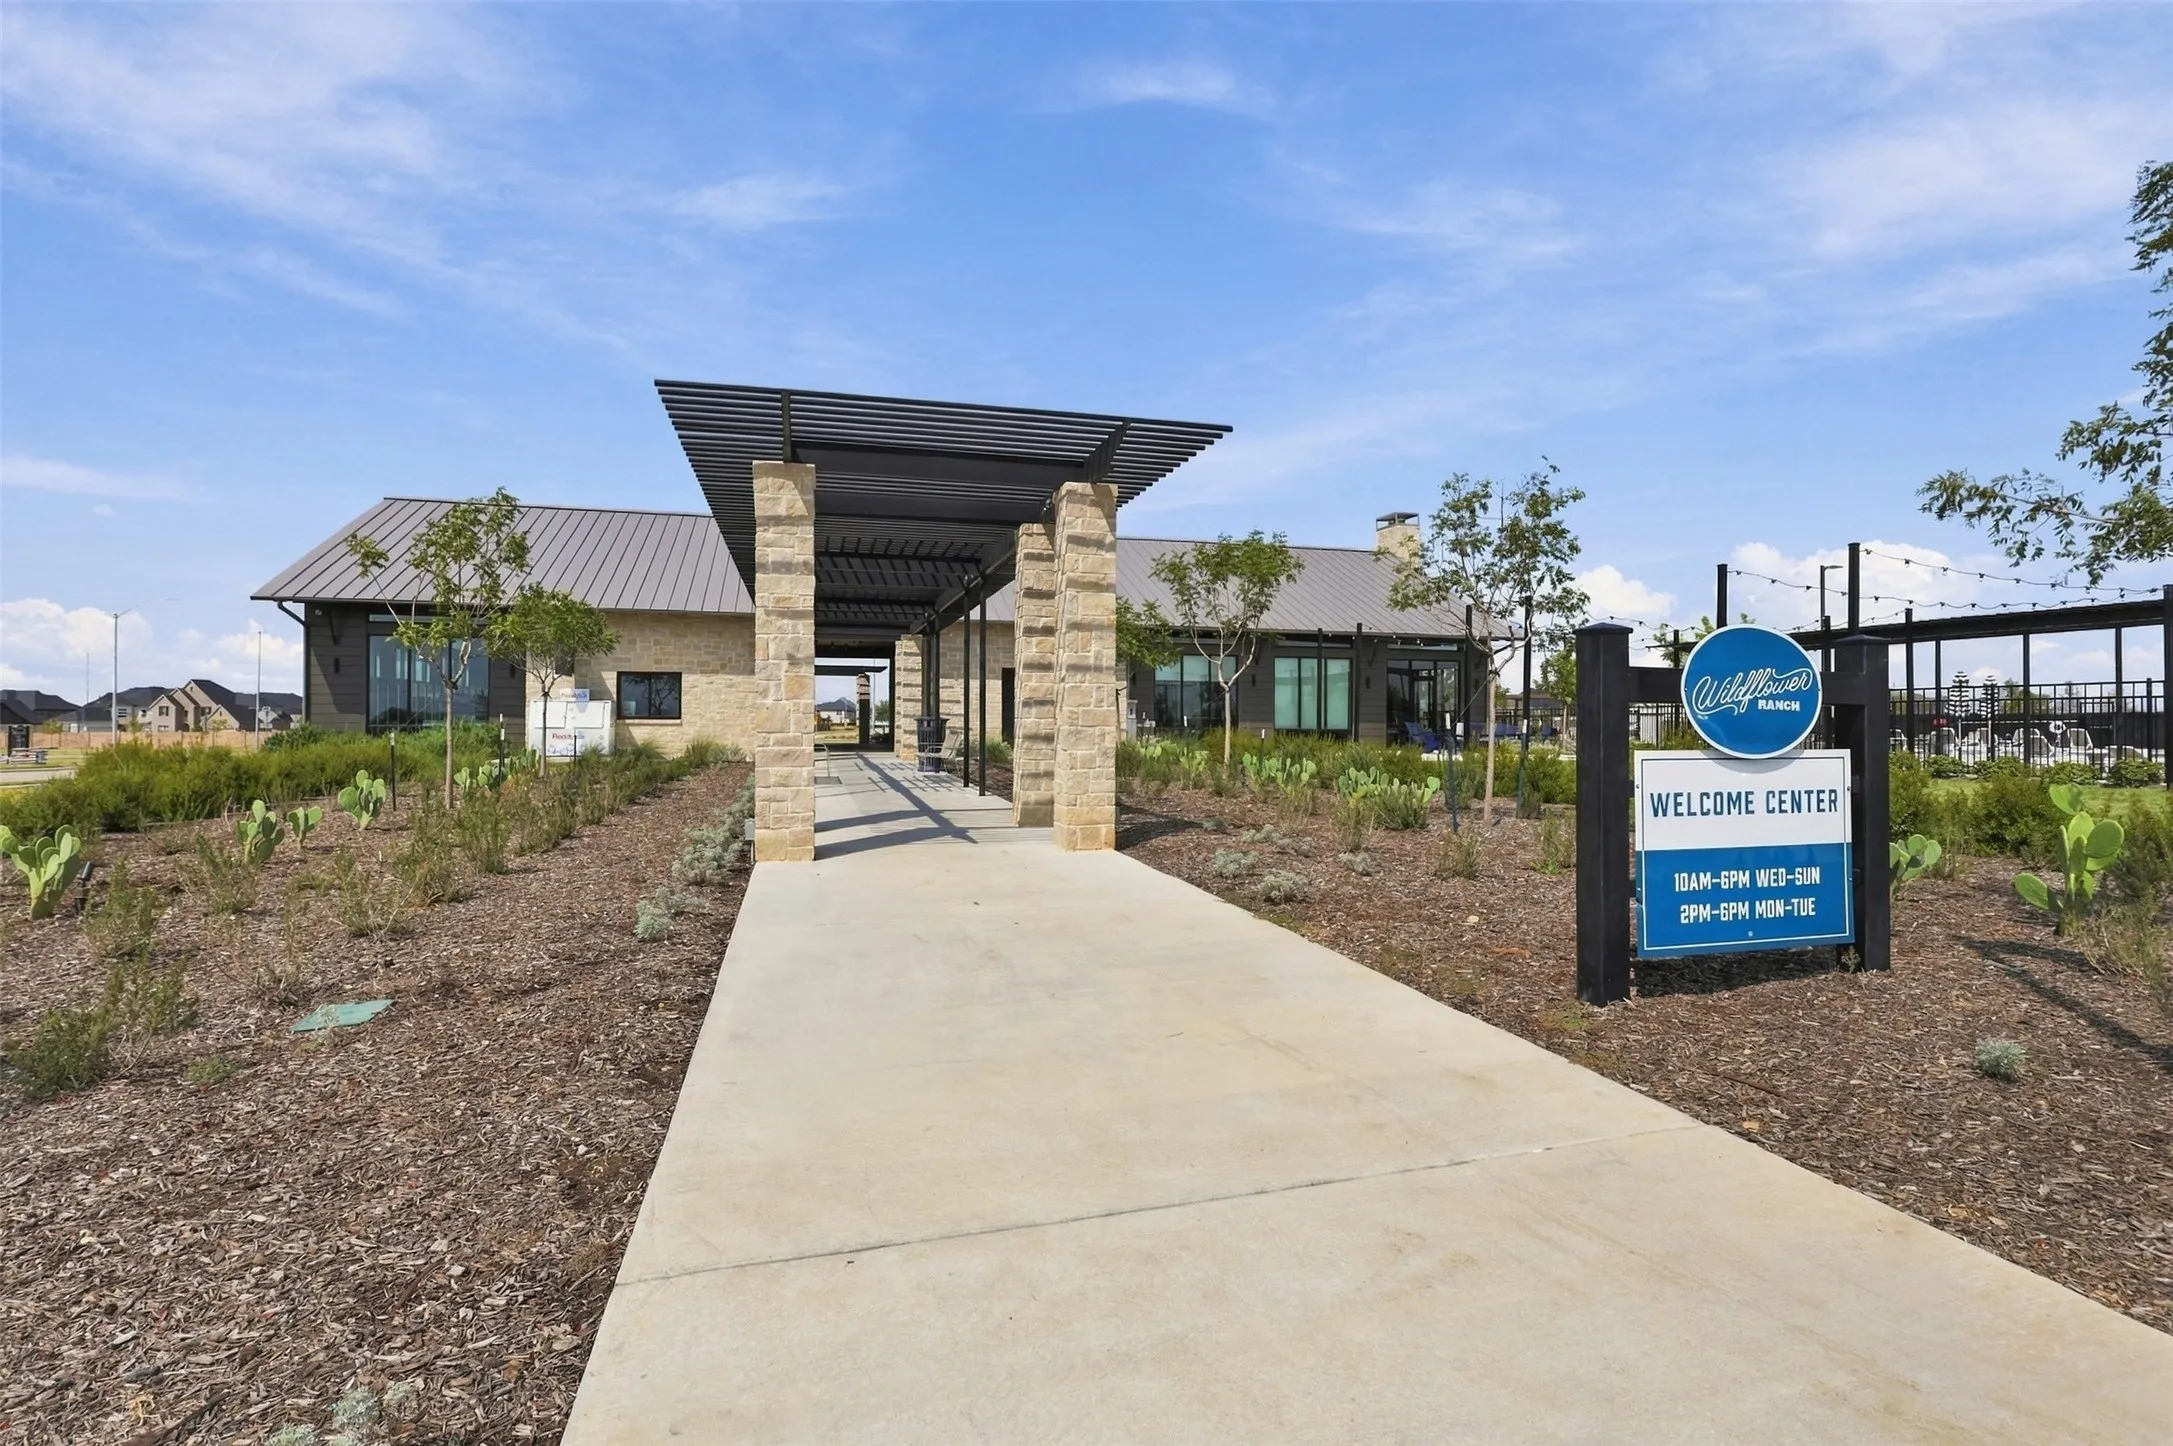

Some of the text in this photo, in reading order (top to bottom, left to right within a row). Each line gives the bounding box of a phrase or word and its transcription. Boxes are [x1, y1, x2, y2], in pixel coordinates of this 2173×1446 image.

[1692, 668, 1813, 715] Wildflower
[1757, 699, 1800, 712] RANCH
[1650, 789, 1838, 817] WELCOME CENTER
[1674, 866, 1820, 892] 10AM-6PM WED-SUN
[1680, 898, 1816, 924] 2PM-6PM MON-TUE
